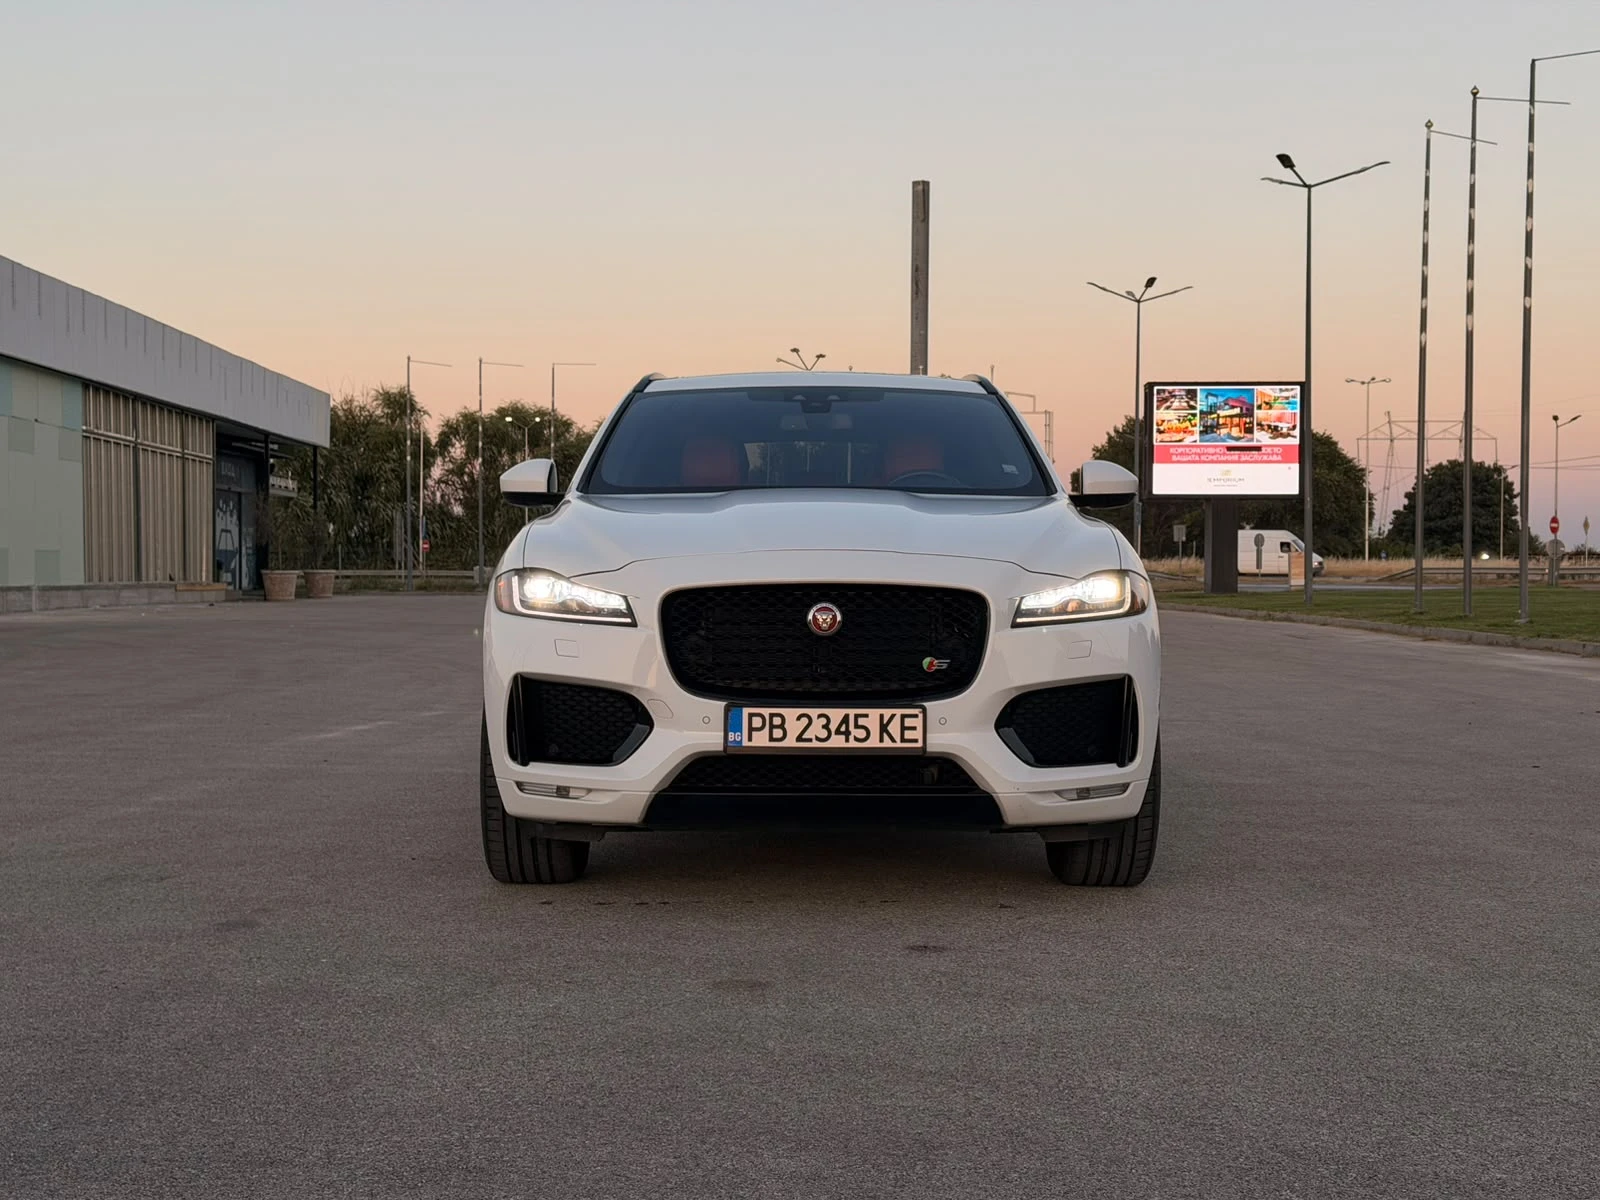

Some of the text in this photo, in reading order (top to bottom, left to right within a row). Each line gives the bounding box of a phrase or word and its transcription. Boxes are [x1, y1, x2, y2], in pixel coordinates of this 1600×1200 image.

[728, 732, 742, 742] BG
[747, 712, 920, 743] PB 2345 KE
